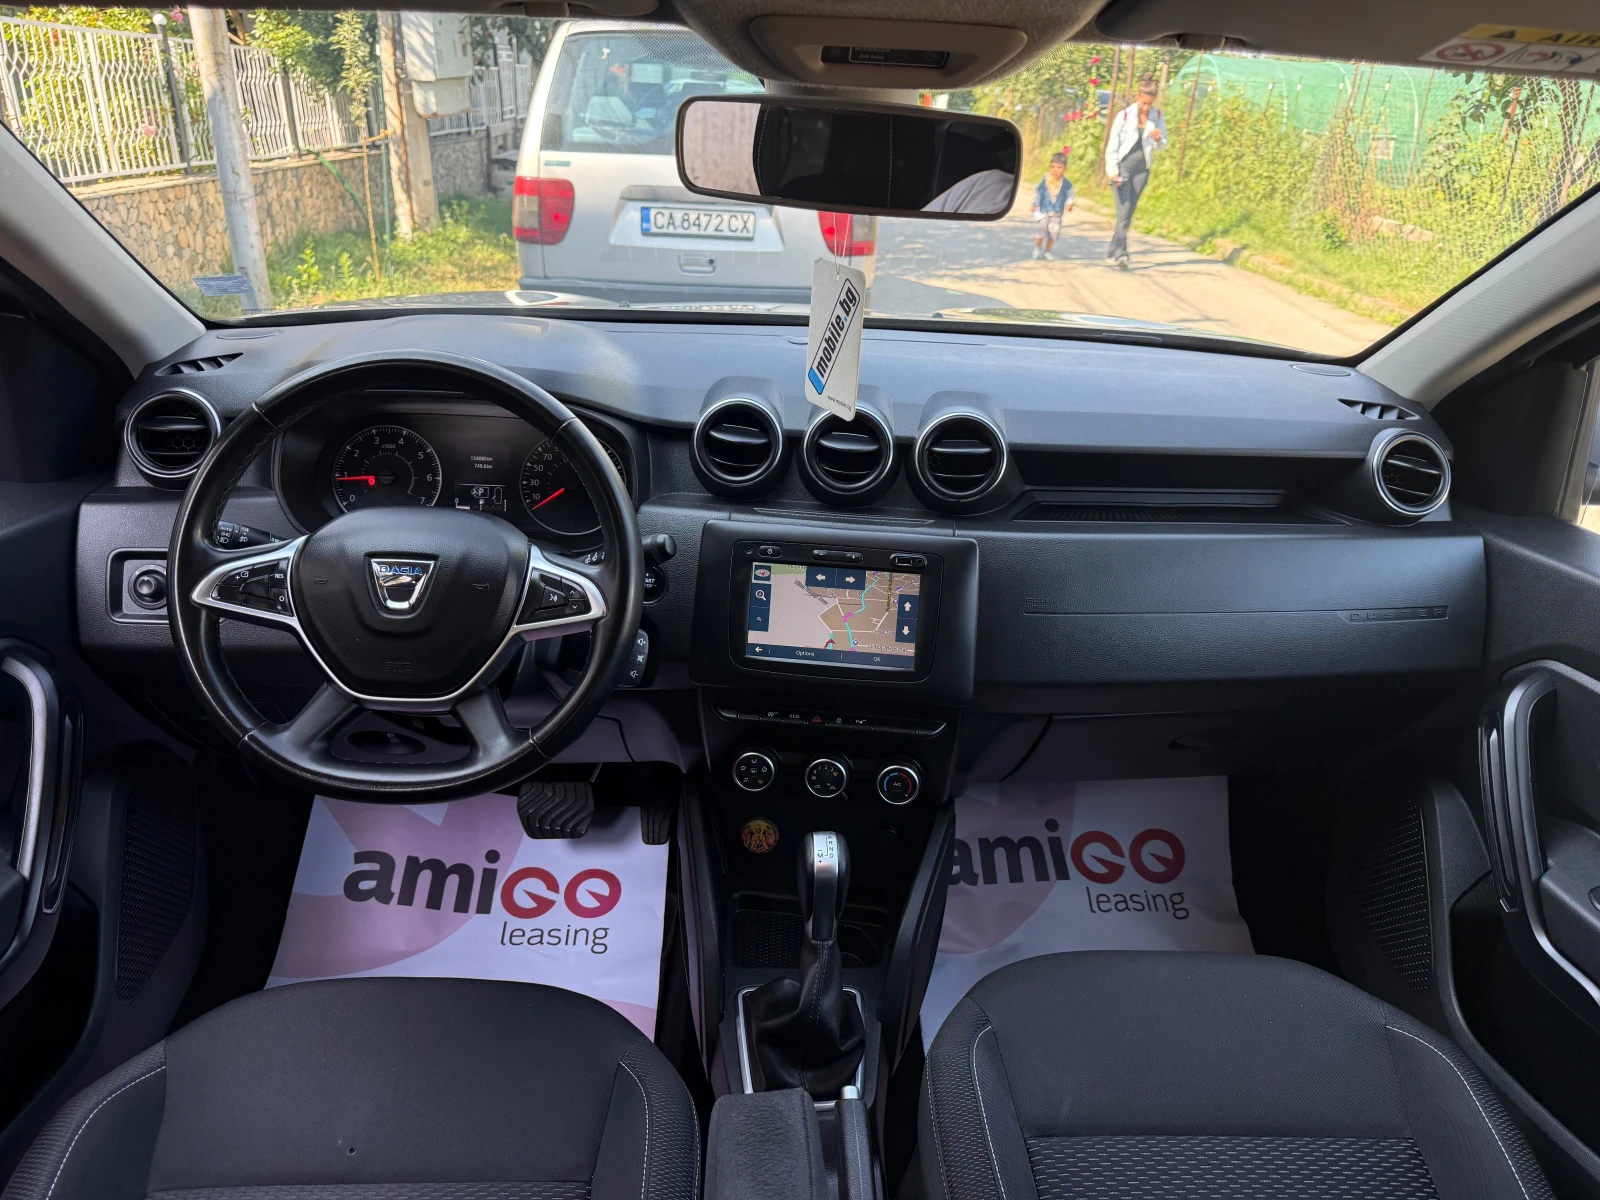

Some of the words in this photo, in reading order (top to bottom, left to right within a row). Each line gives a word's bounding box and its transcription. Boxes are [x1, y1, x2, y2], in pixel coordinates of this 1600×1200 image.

[815, 286, 857, 379] mobile.bg
[374, 436, 380, 445] 3
[398, 437, 404, 446] 4
[353, 449, 360, 458] 2
[418, 451, 424, 460] 5
[543, 453, 553, 461] 70
[533, 464, 544, 472] 50
[426, 473, 433, 482] 6
[529, 478, 540, 487] 30
[349, 494, 356, 503] 0
[419, 496, 426, 505] 7
[532, 492, 541, 501] 10
[379, 564, 423, 576] DACIA
[1350, 607, 1443, 621] DUSTER
[795, 649, 815, 657] Options
[1085, 886, 1190, 920] leasing
[499, 920, 610, 955] leasing
